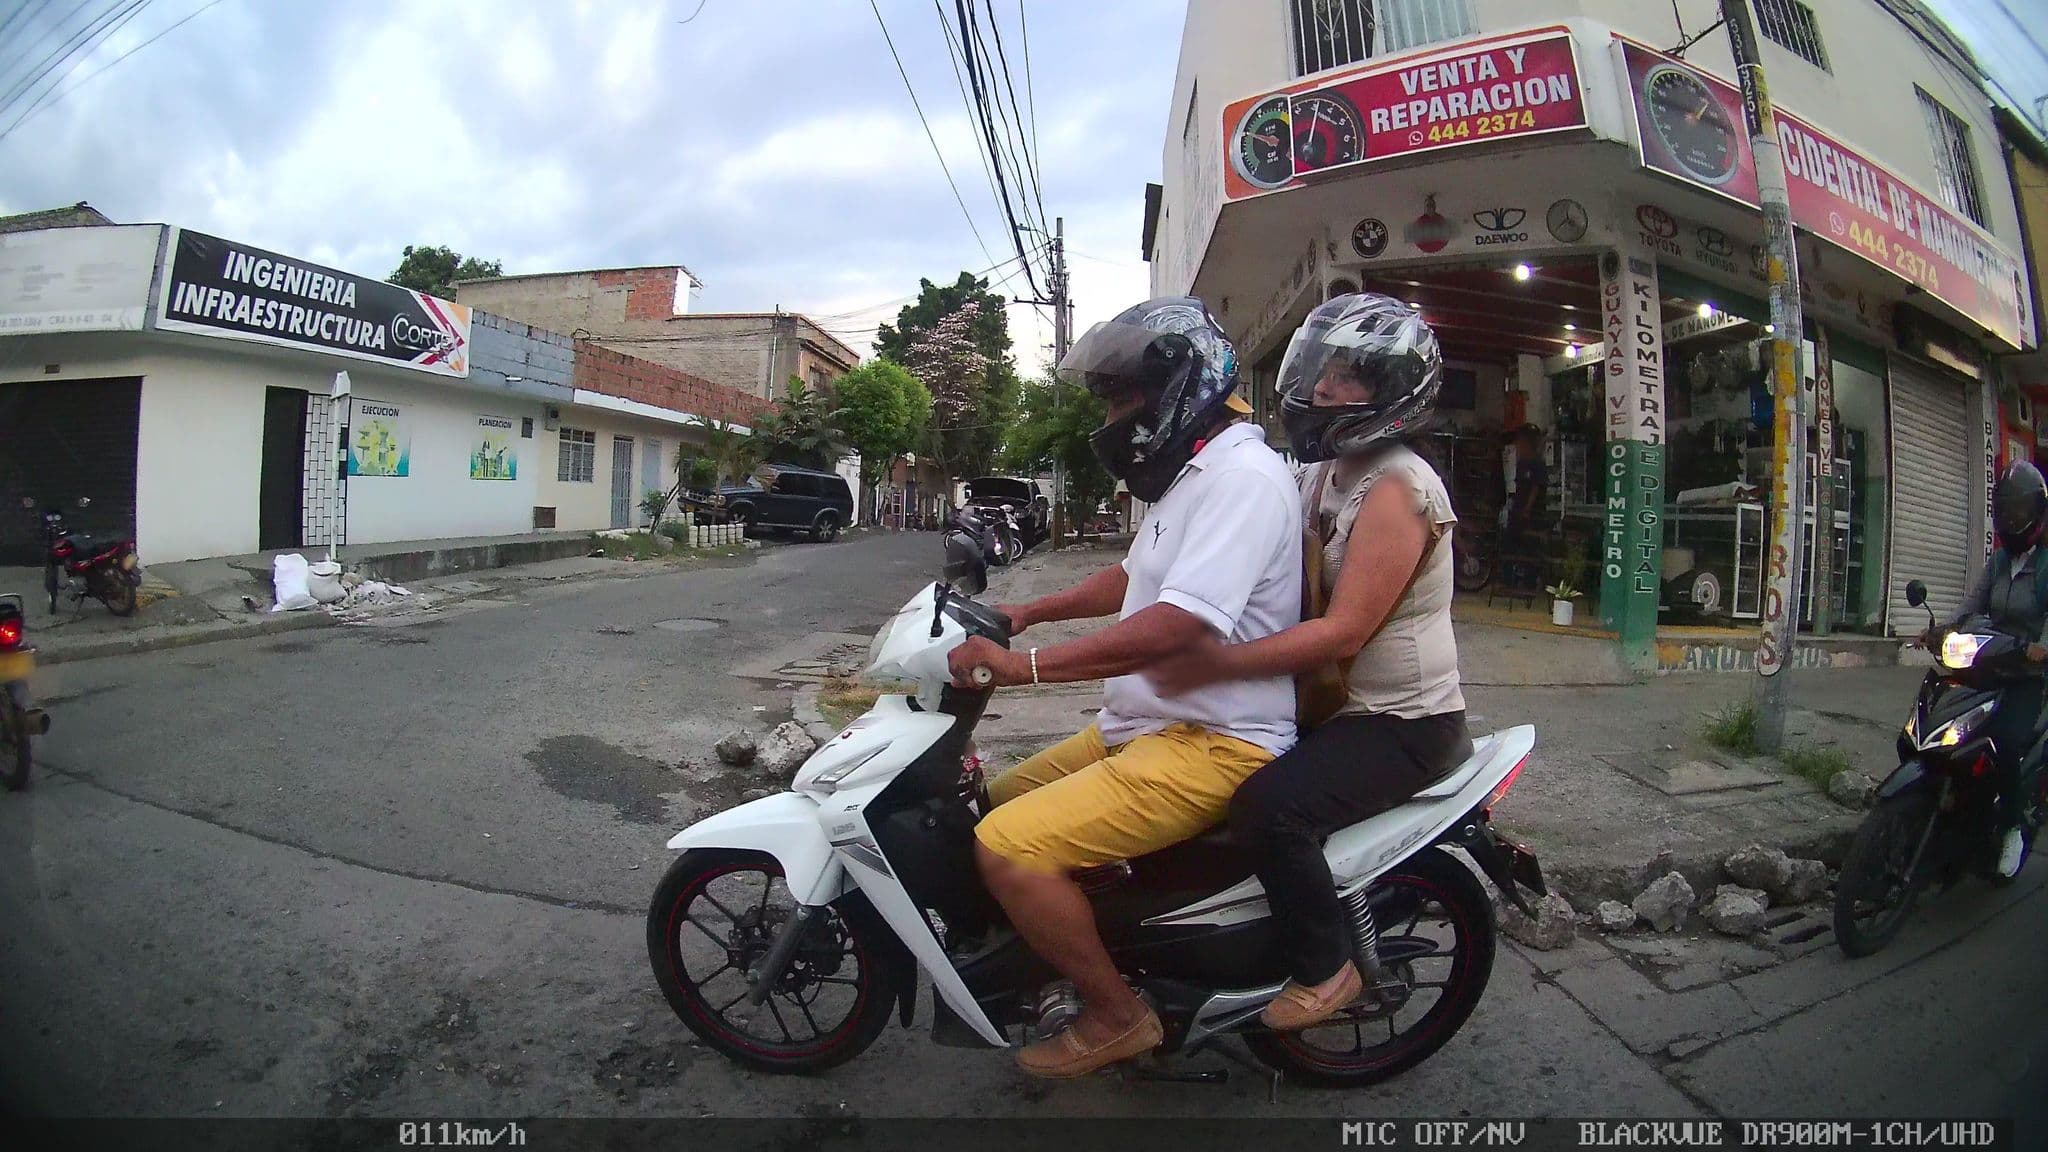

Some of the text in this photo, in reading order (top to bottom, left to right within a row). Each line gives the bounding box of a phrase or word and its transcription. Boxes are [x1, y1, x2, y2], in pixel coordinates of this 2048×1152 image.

[1399, 47, 1526, 96] VENTA Y
[1371, 74, 1573, 134] REPARACION
[1428, 110, 1536, 143] 444 2374
[1742, 104, 1889, 224] CIDENTAL
[1888, 182, 1916, 239] DE
[1475, 232, 1528, 246] DAEWOO
[1639, 231, 1682, 257] TOYOTA
[1848, 220, 1940, 290] 444 2374
[223, 250, 357, 309] INGENIERIA
[172, 281, 386, 351] INFRAESTRUCTURA
[1633, 282, 1661, 466] KILOMETRAJE
[361, 405, 400, 417] EJECUCION
[478, 418, 513, 429] PLANEACION
[1604, 283, 1629, 580] GUAYAS VELOCIMETRO
[1984, 421, 1994, 563] BARBER SH
[1634, 475, 1659, 594] DIGITAL
